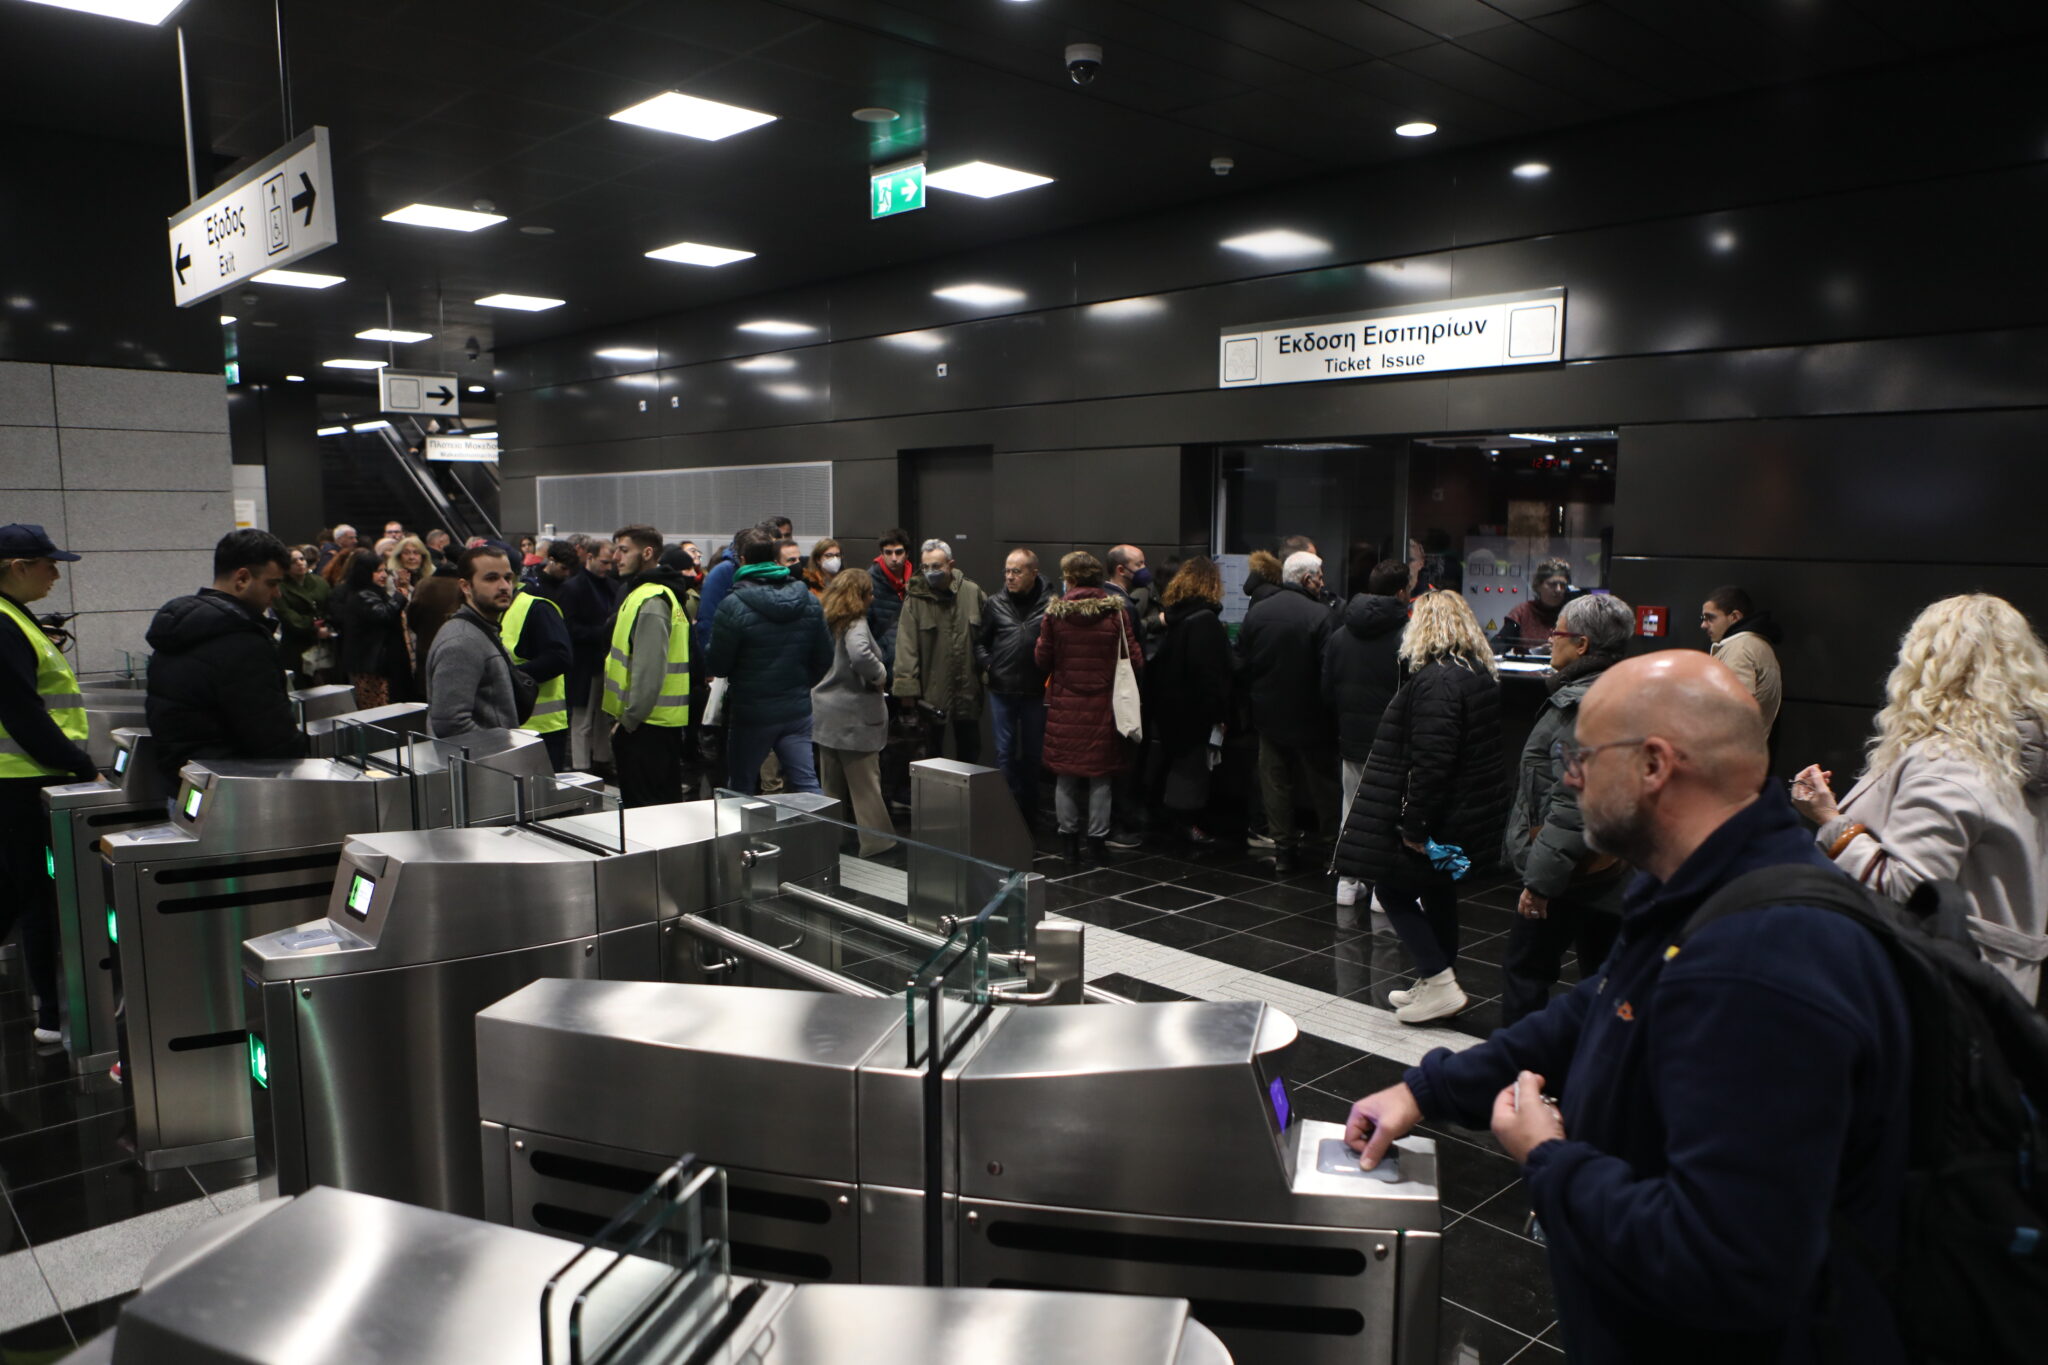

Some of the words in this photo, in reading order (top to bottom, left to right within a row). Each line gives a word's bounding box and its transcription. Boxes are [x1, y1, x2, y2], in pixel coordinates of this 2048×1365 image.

[219, 251, 236, 277] Exit
[1274, 332, 1356, 354] Έκδοση
[1363, 317, 1488, 346] Εισιτηρίων
[1324, 357, 1372, 373] Ticket
[1381, 353, 1426, 369] Issue
